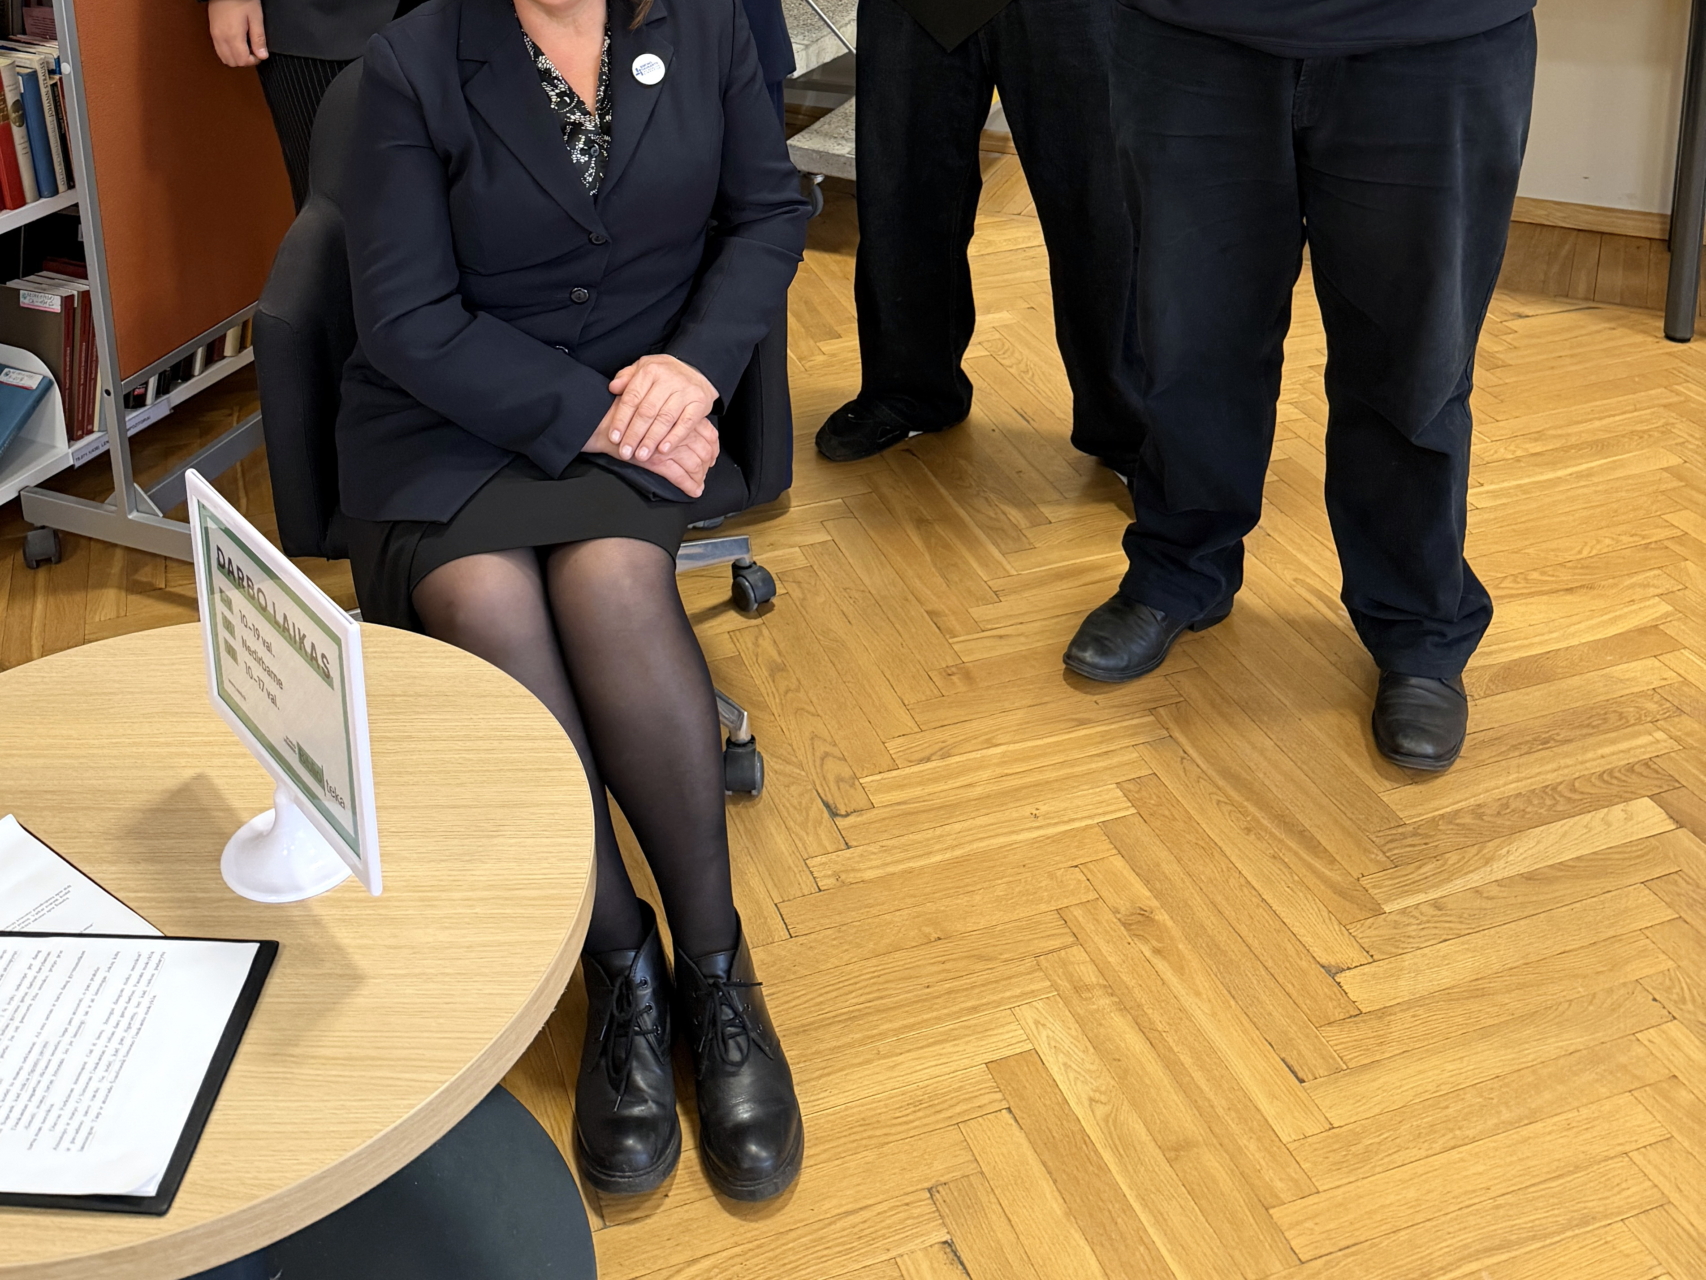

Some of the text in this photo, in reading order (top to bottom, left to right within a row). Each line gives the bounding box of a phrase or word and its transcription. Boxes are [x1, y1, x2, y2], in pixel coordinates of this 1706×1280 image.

[216, 544, 330, 680] DARBO LAIKAS
[241, 634, 283, 691] Nedirbame
[260, 631, 275, 658] val.
[265, 683, 279, 711] val.
